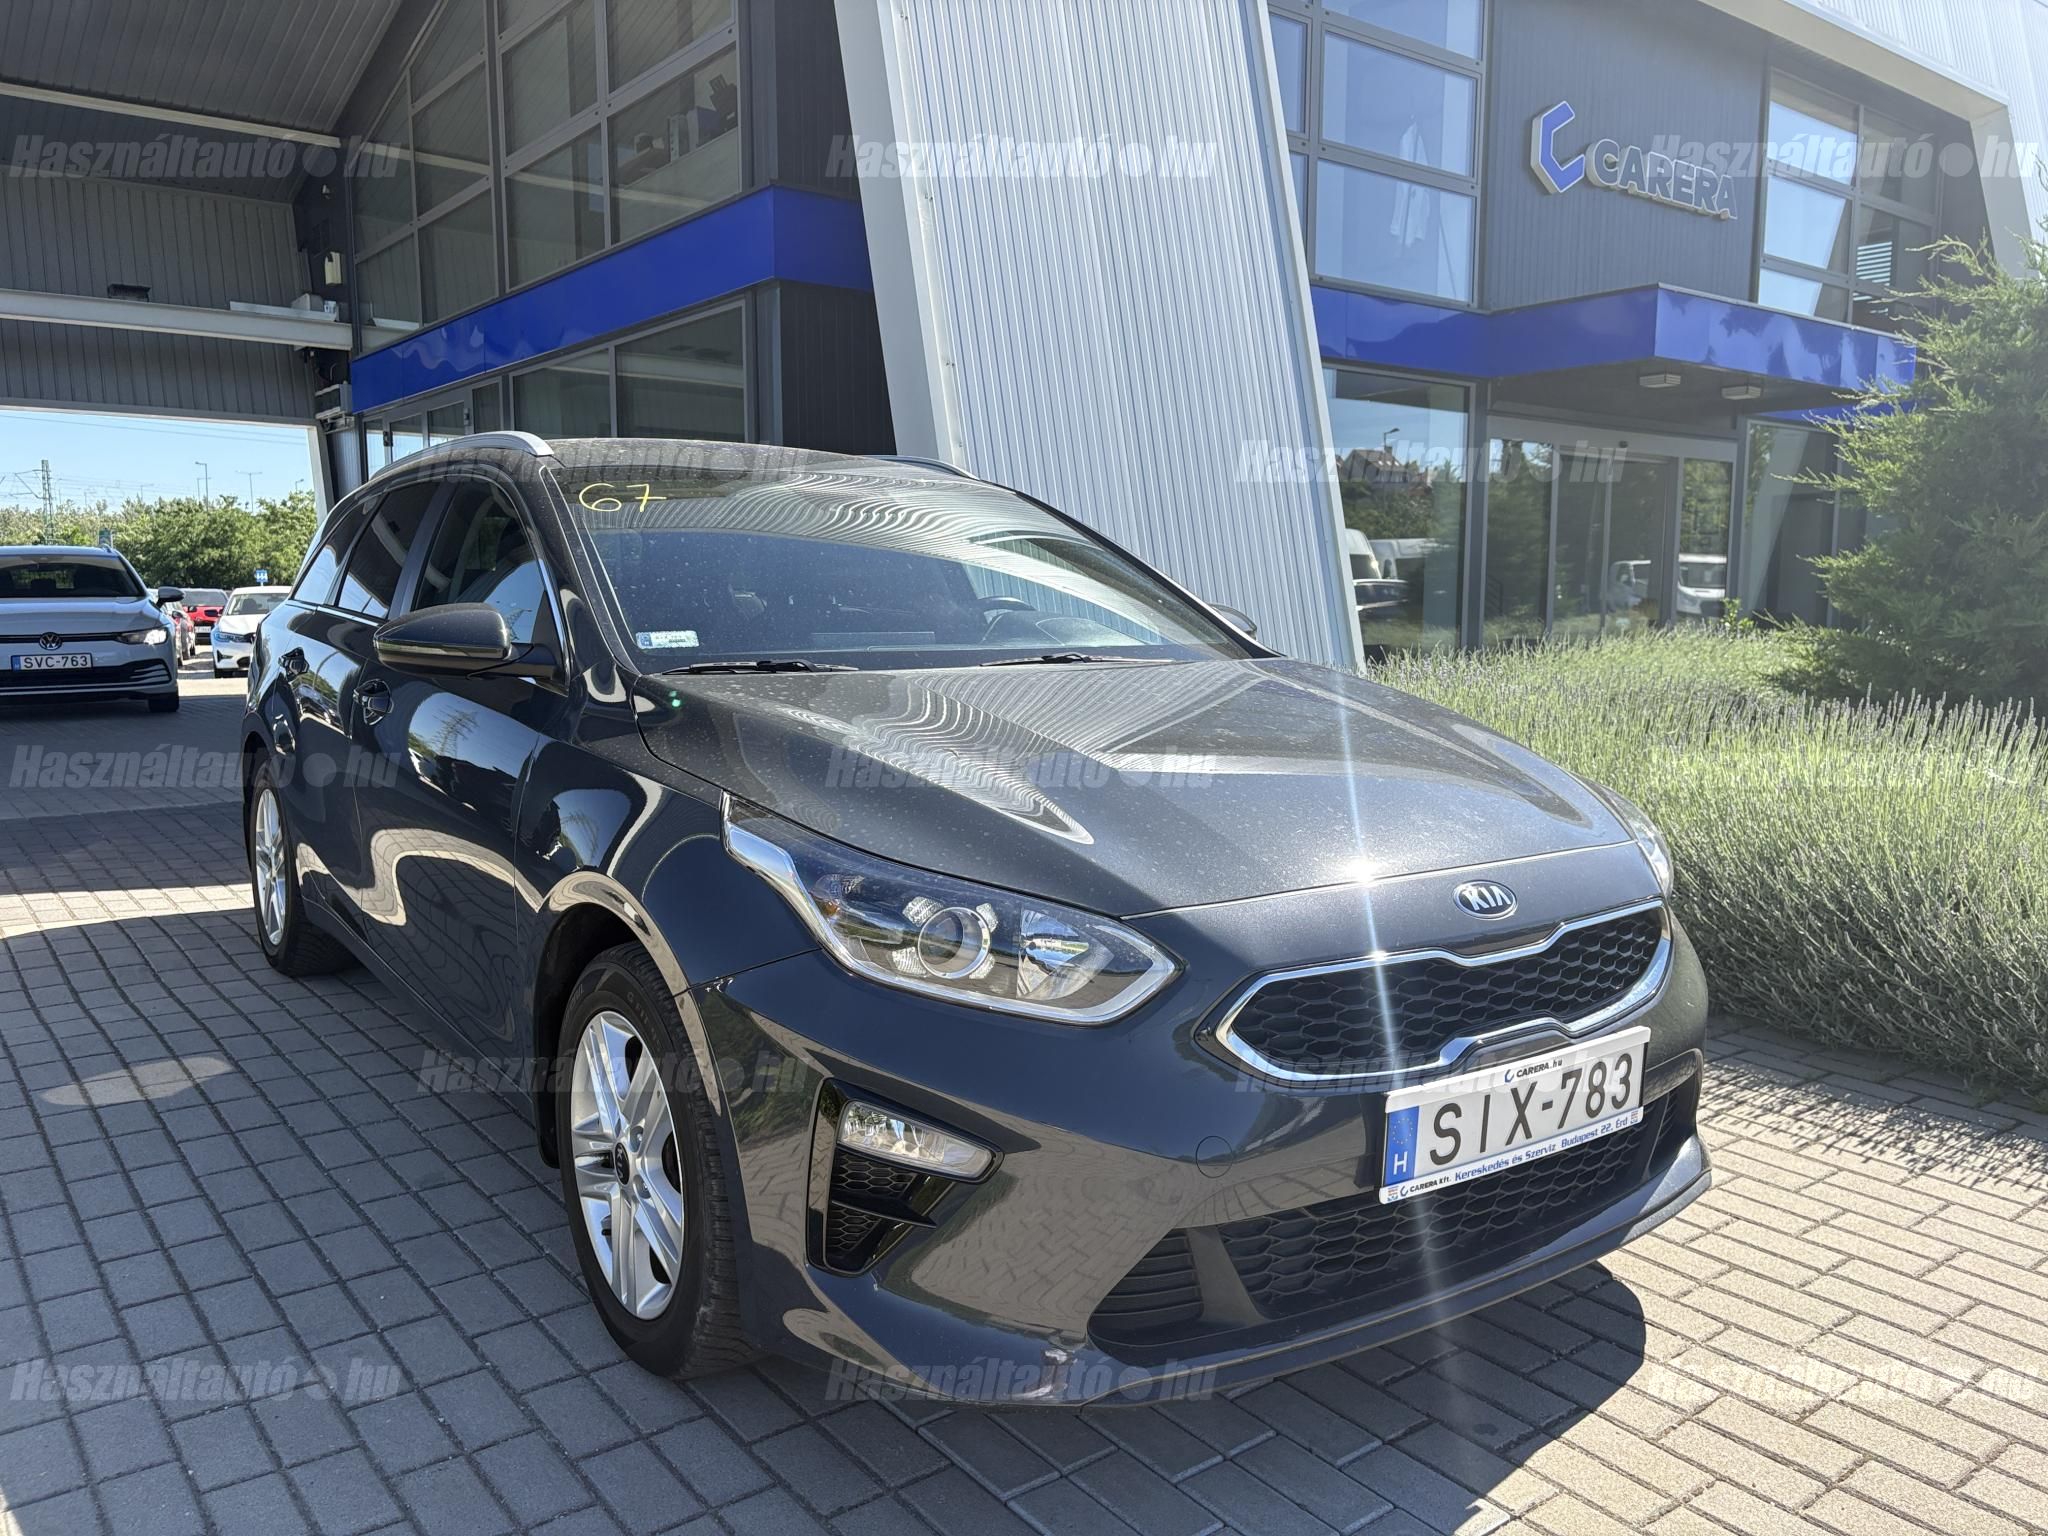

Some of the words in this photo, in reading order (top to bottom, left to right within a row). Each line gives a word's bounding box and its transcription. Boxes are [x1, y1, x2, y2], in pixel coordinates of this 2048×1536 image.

[1586, 138, 1738, 220] CARERA
[578, 482, 667, 513] 67
[24, 655, 88, 669] SVC-763
[1461, 885, 1512, 911] KIA
[1516, 1058, 1563, 1078] CARERA.hu
[1429, 1053, 1633, 1166] SIX-783
[1393, 1151, 1408, 1175] H
[1409, 1179, 1438, 1193] CARERA
[1455, 1157, 1510, 1182] Kereskedés
[1512, 1152, 1523, 1164] és
[1561, 1128, 1599, 1148] Budapest
[1616, 1115, 1628, 1129] Érd
